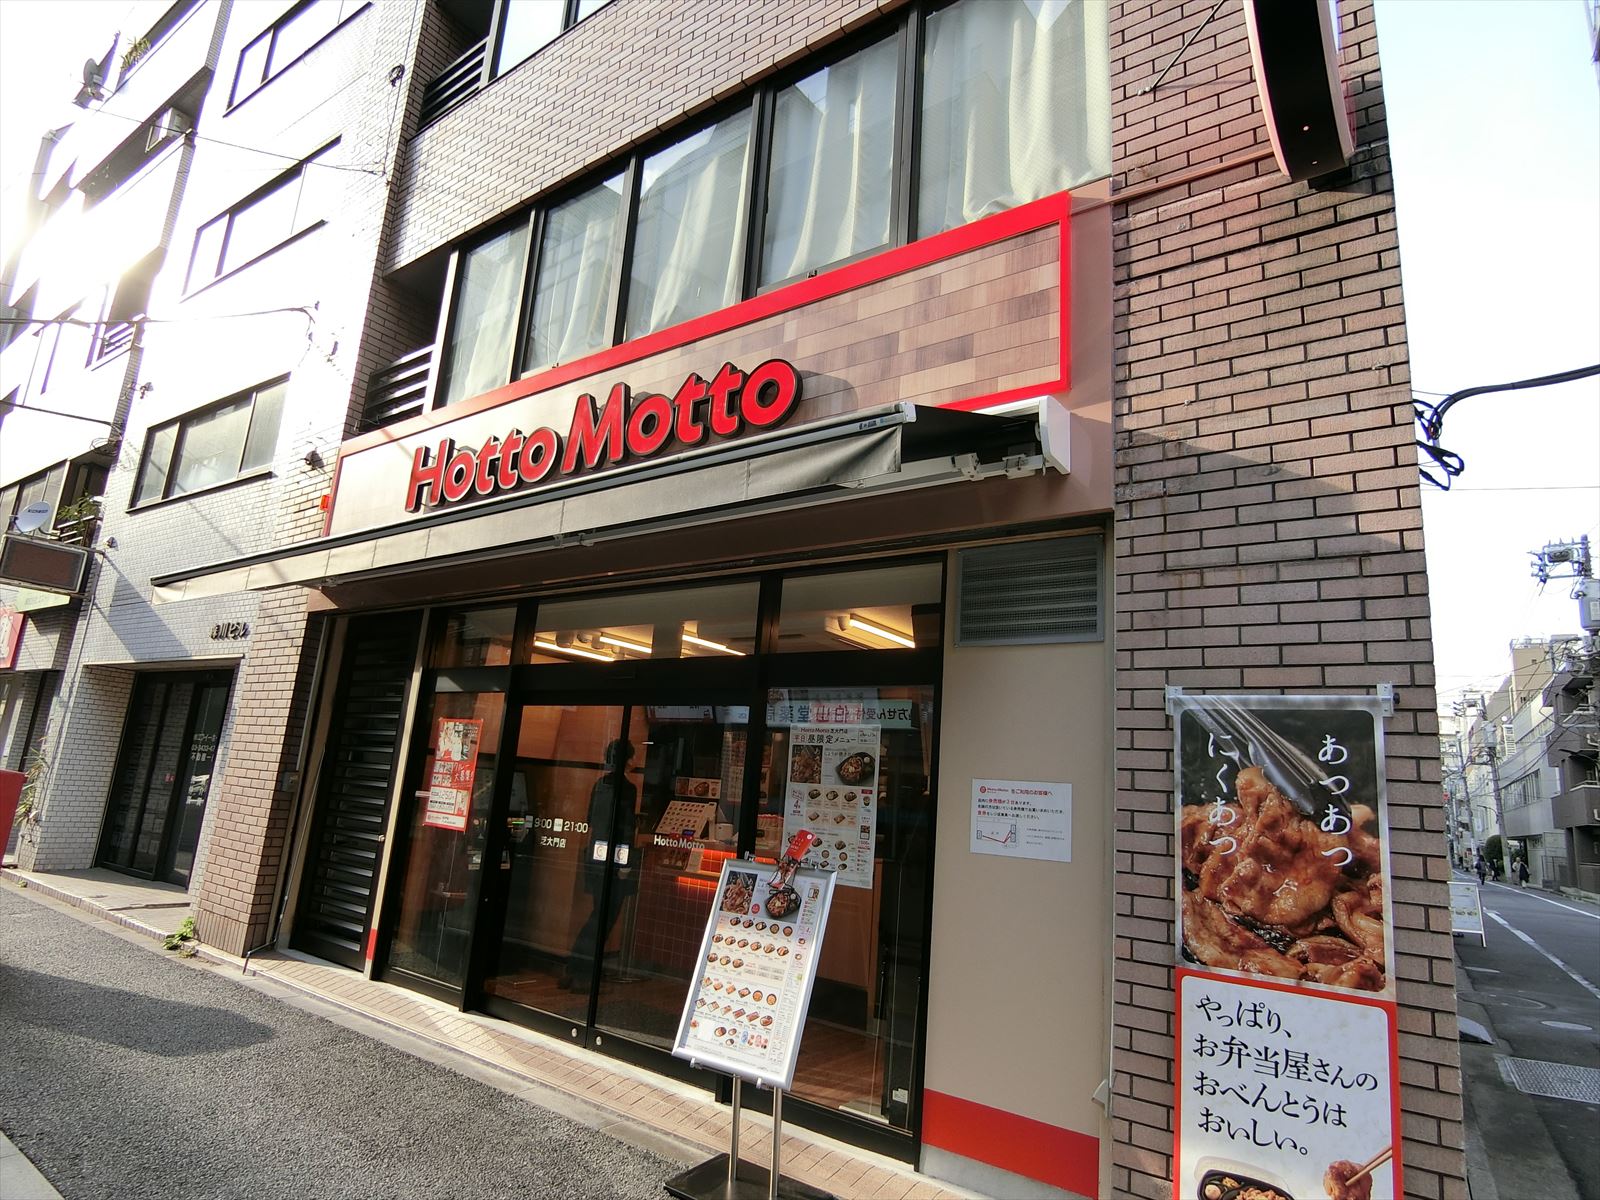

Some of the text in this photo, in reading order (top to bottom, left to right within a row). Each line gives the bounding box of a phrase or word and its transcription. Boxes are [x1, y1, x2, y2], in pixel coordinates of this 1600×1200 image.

[1208, 732, 1237, 855] にくあつ
[1318, 734, 1353, 867] あつあつ
[540, 836, 567, 848] 芝大門店
[563, 821, 589, 833] 21:00
[1195, 994, 1292, 1038] やっぱり、
[1192, 1033, 1379, 1091] お弁当屋さんの
[1192, 1070, 1348, 1128] おべんとうは
[1197, 1106, 1308, 1156] おいしい。
